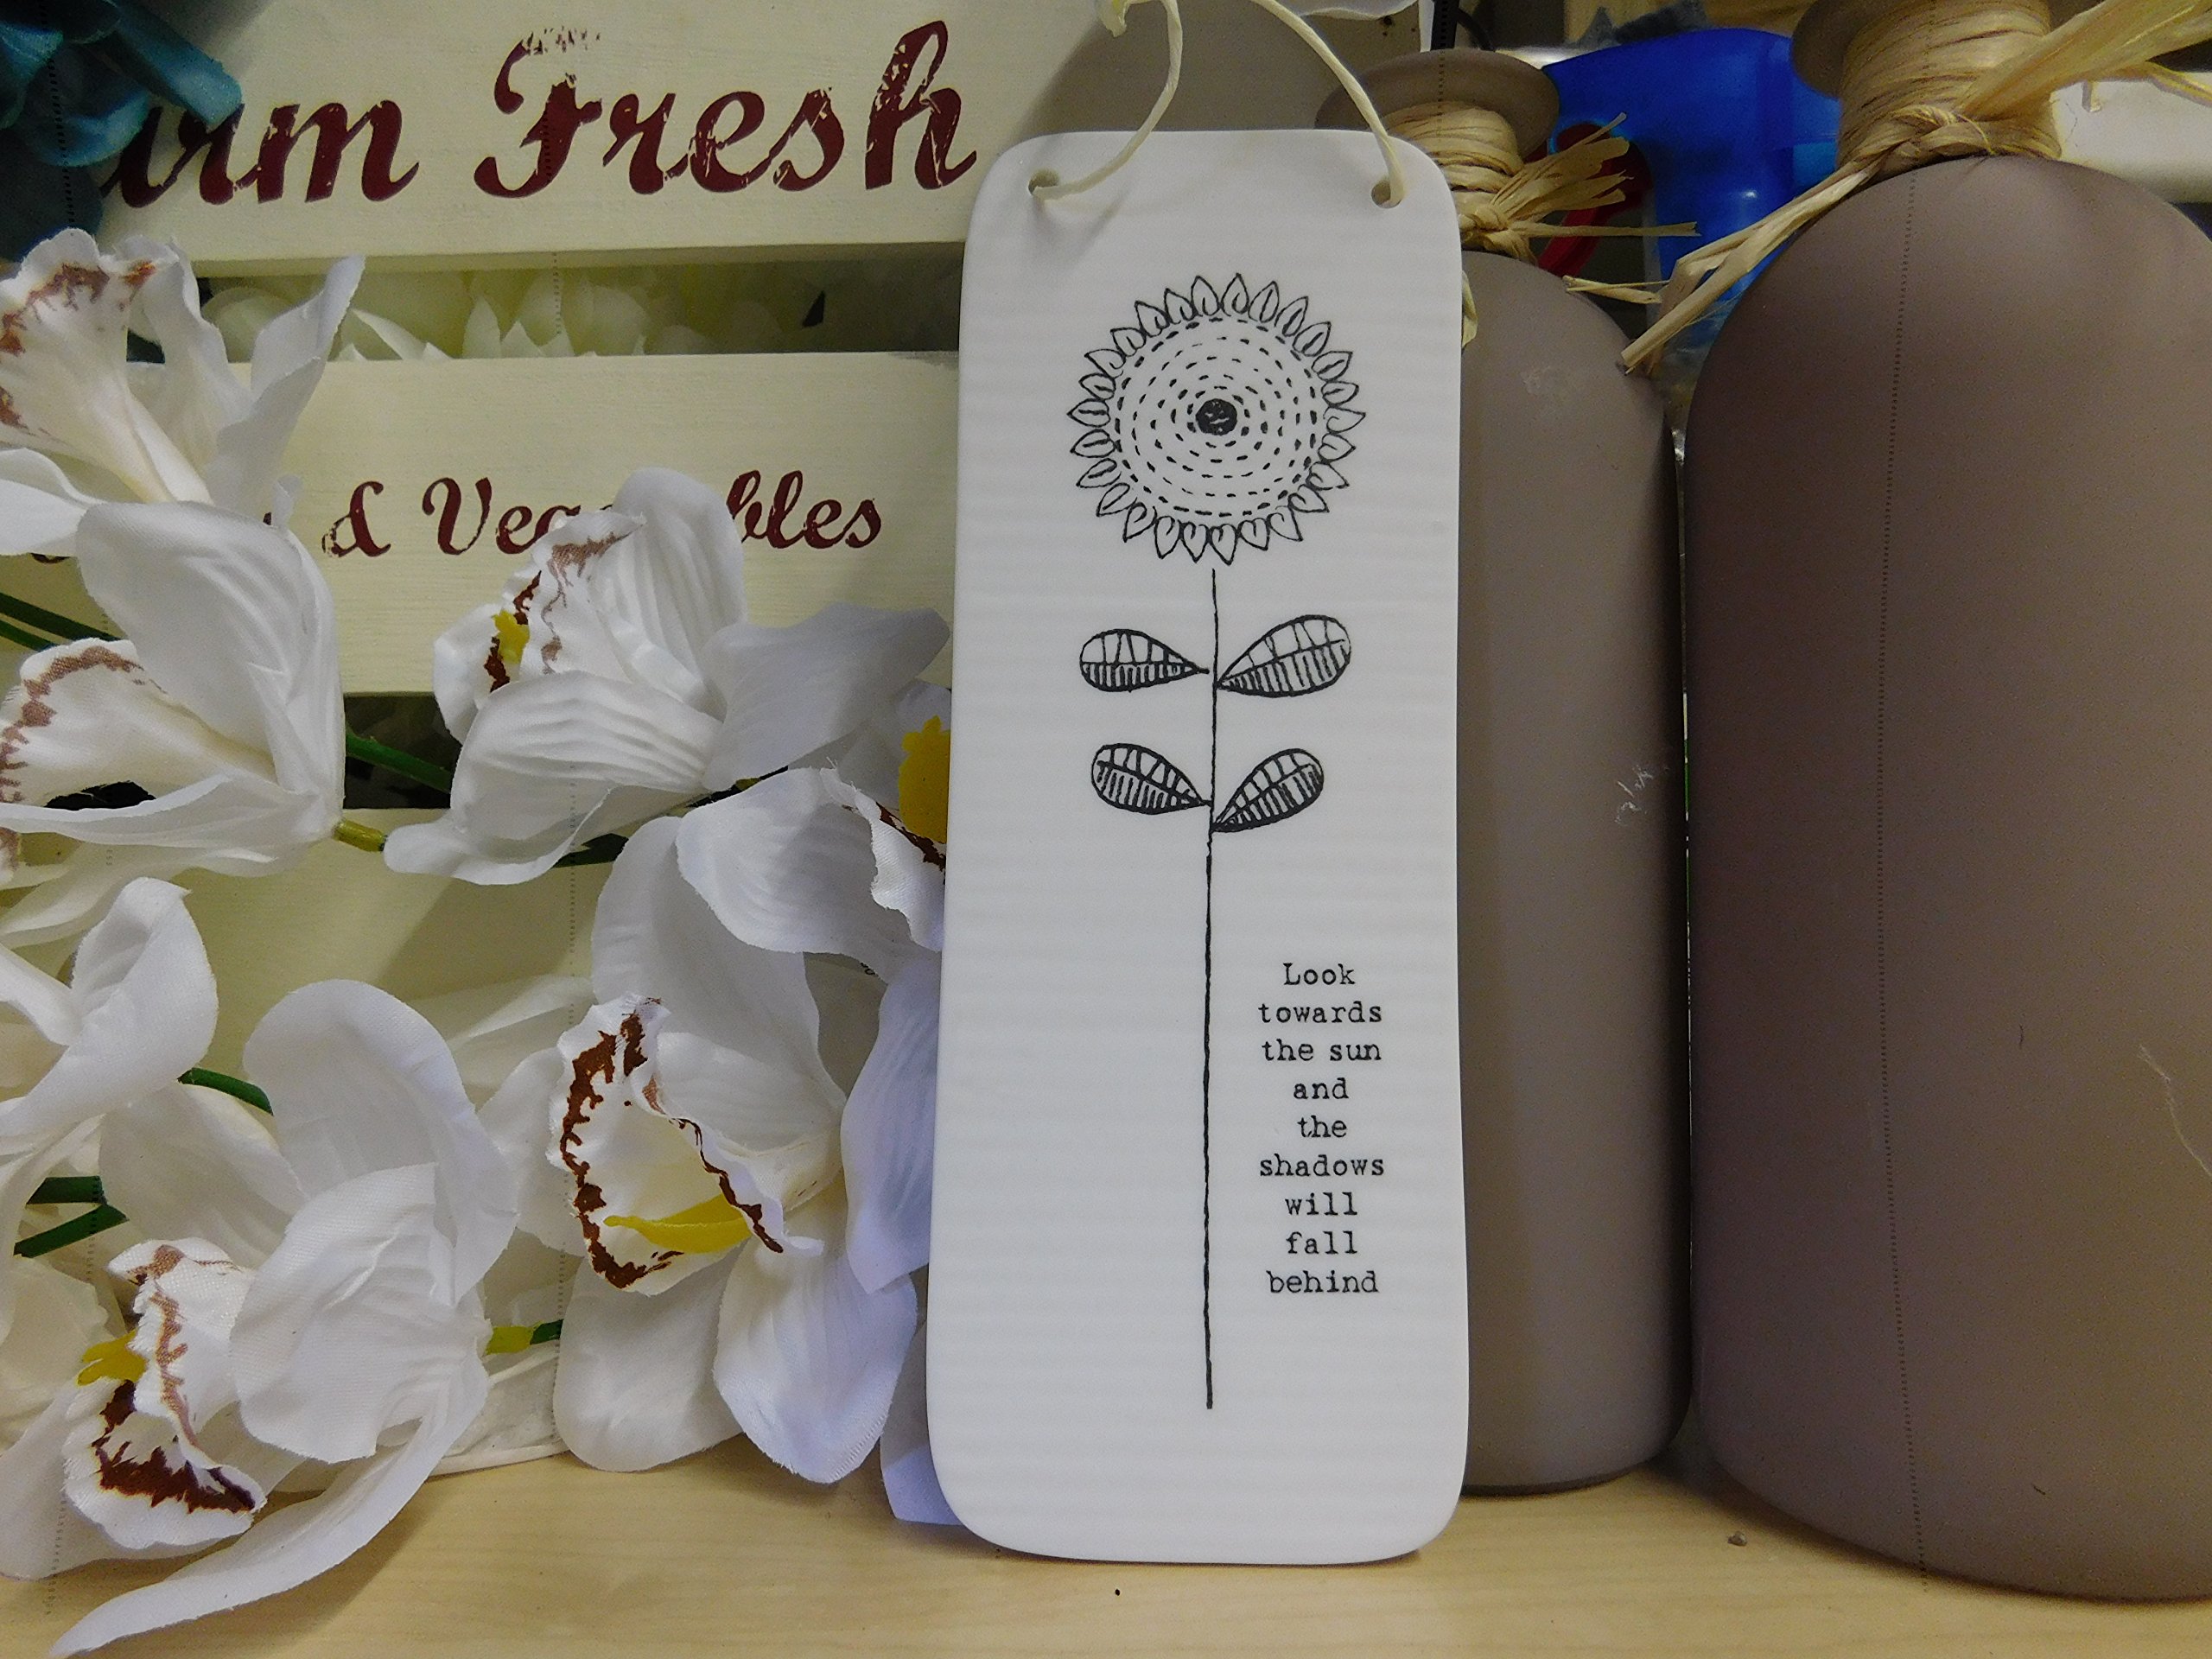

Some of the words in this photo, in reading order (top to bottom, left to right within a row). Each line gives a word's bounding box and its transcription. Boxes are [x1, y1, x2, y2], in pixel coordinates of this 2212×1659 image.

[99, 99, 420, 208] rm
[474, 21, 977, 199] Fresh
[321, 480, 391, 557] &
[1282, 962, 1357, 986] Look
[1257, 1000, 1382, 1024] towards
[1261, 1038, 1314, 1062] the
[1329, 1042, 1382, 1062] sun
[1293, 1077, 1350, 1100] and
[1296, 1115, 1348, 1139] the
[1259, 1153, 1385, 1178] shadows
[1284, 1191, 1358, 1217] will
[1285, 1230, 1358, 1255] fall
[1265, 1269, 1380, 1294] behind
